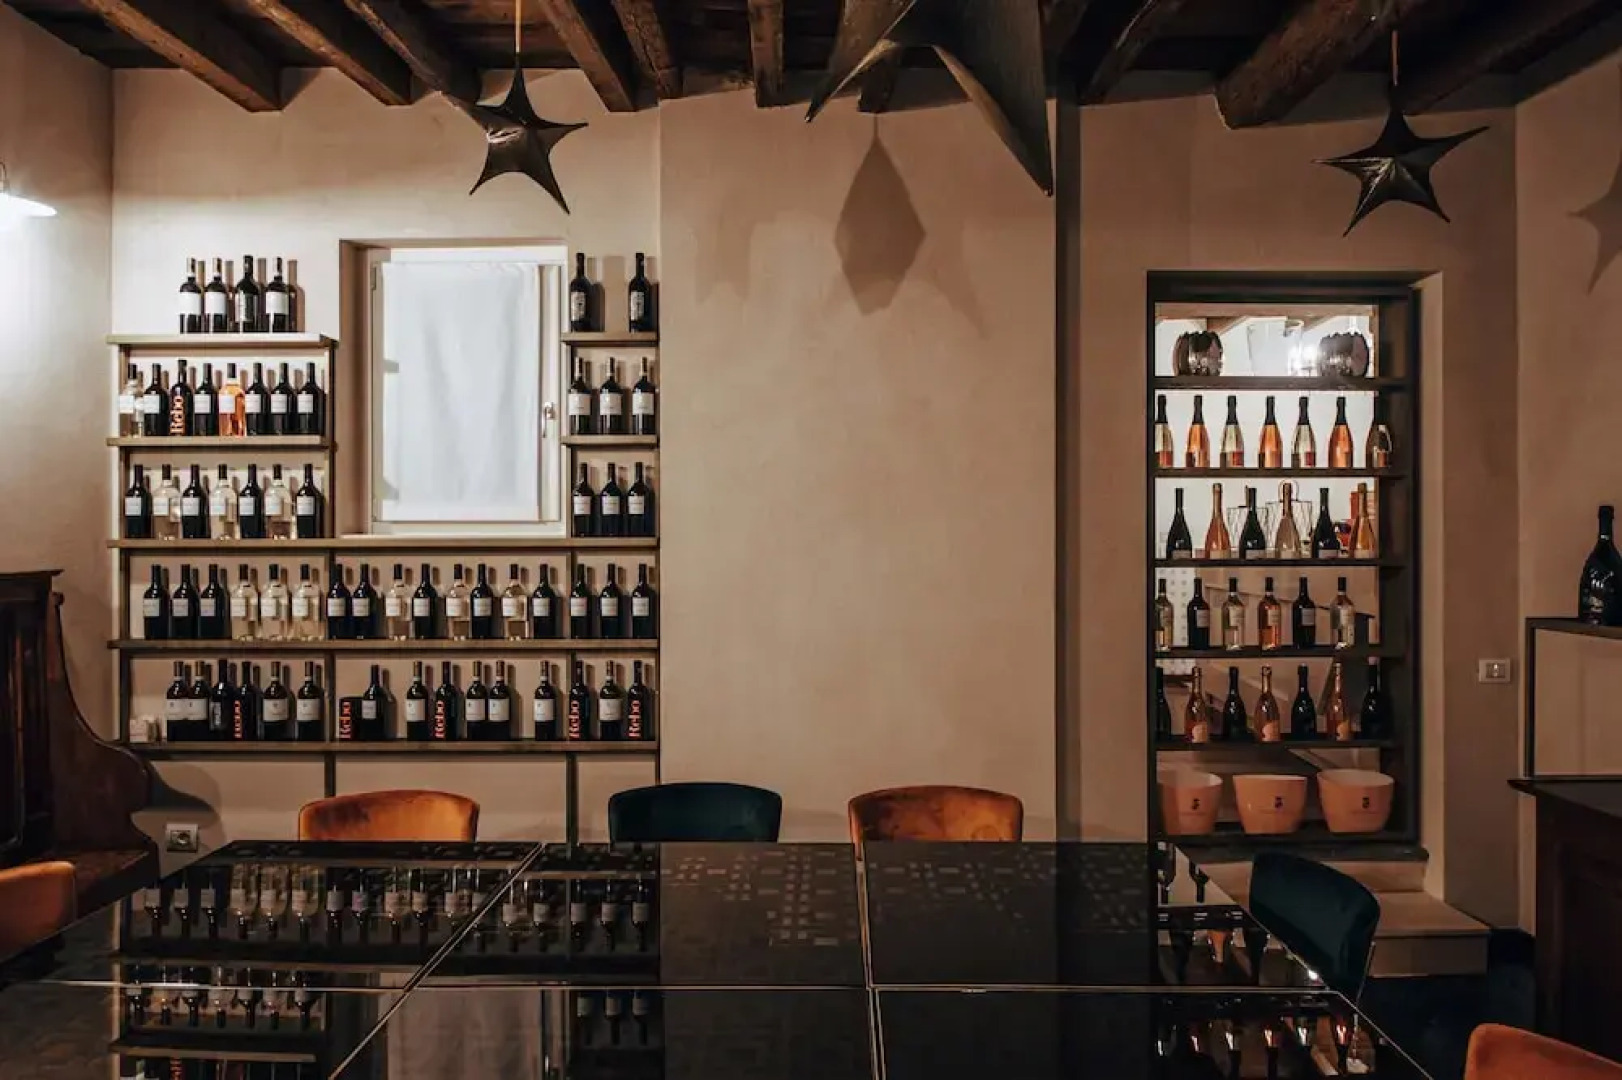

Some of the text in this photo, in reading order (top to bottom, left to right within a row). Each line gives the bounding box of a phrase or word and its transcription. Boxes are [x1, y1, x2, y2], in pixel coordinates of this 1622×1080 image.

[170, 395, 184, 434] Rebo
[569, 700, 579, 737] Rebo
[629, 700, 641, 737] Rebo
